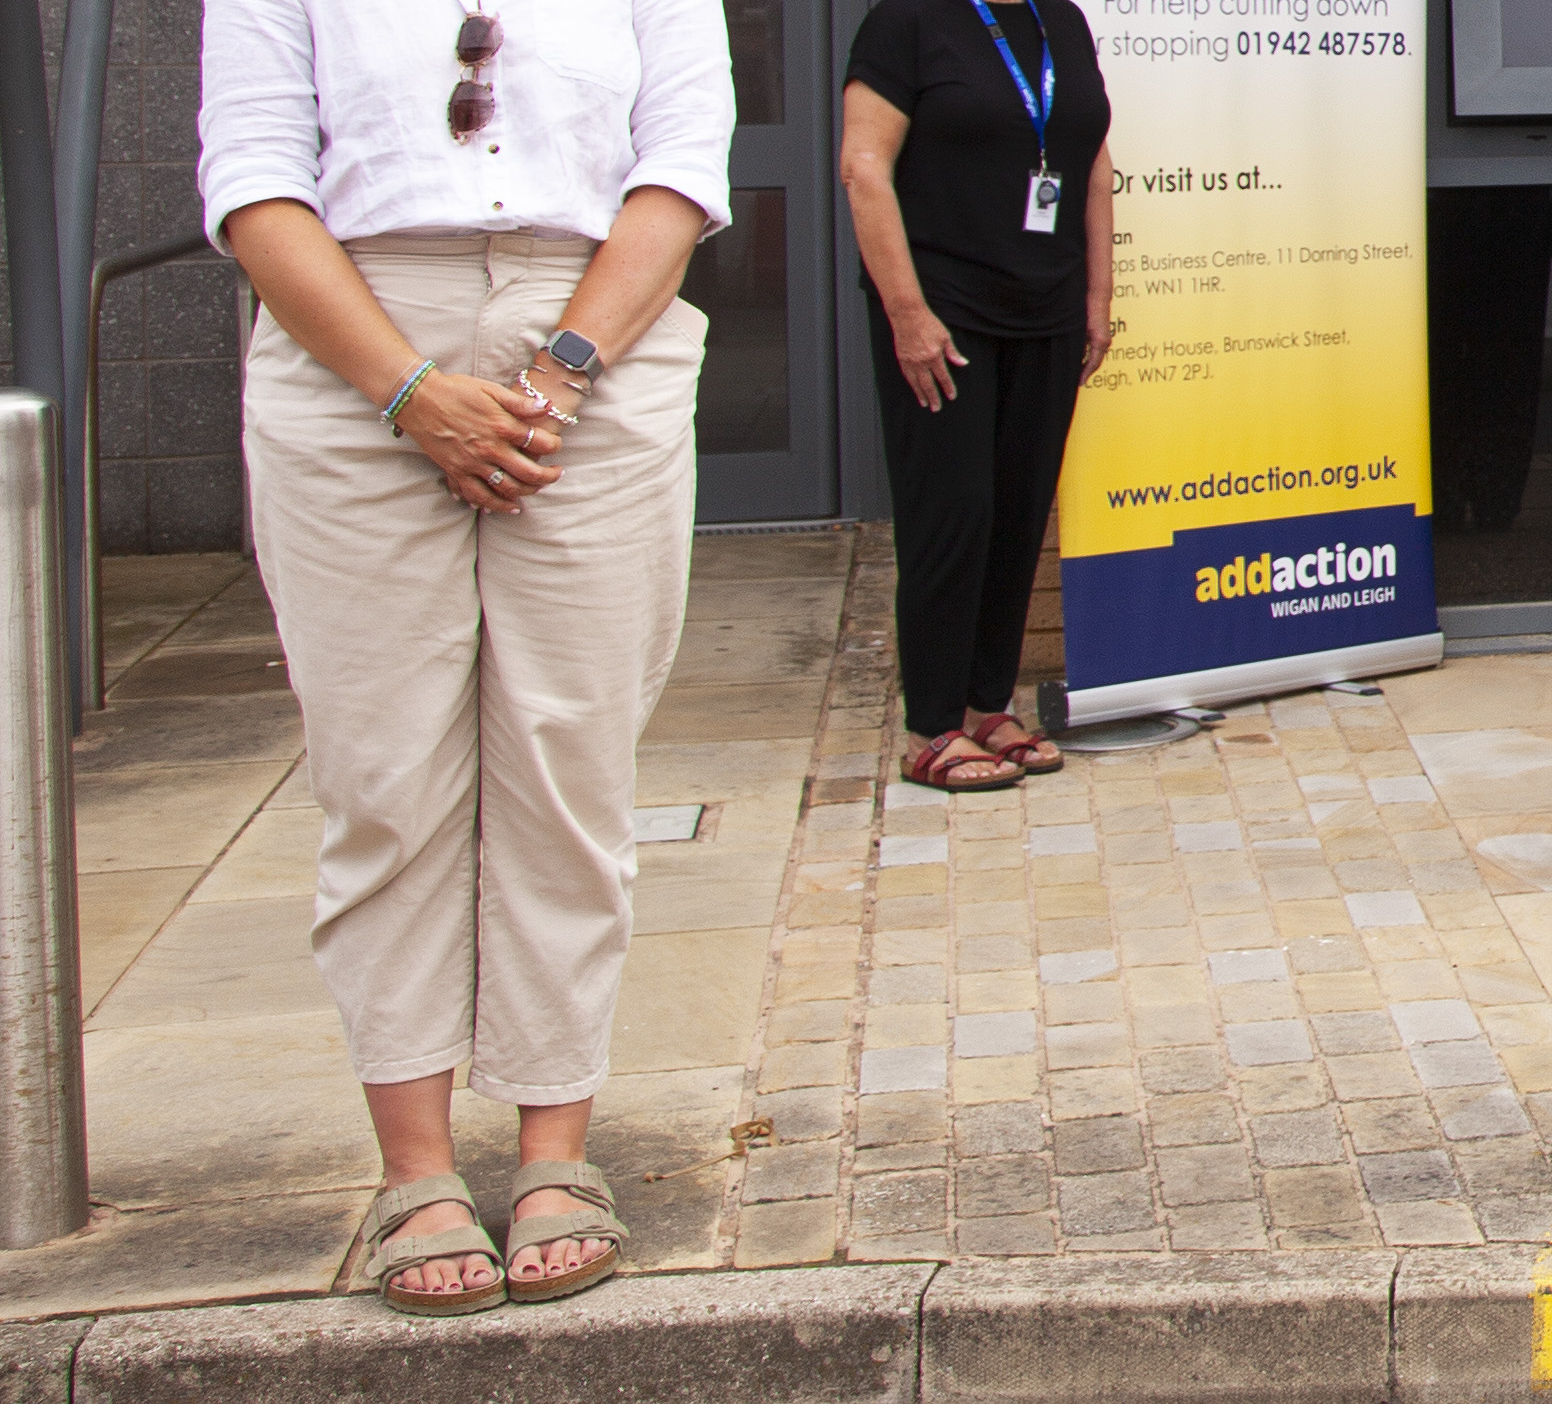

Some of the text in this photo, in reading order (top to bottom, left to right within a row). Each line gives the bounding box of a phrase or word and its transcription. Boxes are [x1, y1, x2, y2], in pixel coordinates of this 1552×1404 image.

[1112, 31, 1228, 62] stopping
[1236, 31, 1311, 56] 01942
[1318, 31, 1412, 56] 487578.
[1143, 168, 1193, 193] visit
[1202, 171, 1227, 191] us
[1236, 166, 1282, 190] at...
[1141, 251, 1207, 272] Business
[1212, 249, 1271, 268] Centre,
[1277, 248, 1292, 264] 11
[1300, 246, 1358, 264] Dorning
[1362, 243, 1413, 260] Street,
[1145, 279, 1183, 296] WN1
[1191, 277, 1225, 294] 1HR.
[1107, 329, 1350, 363] nnedy House, Brunswick Street,
[1138, 366, 1176, 383] WN7
[1182, 364, 1213, 382] 2PJ.
[1106, 455, 1397, 509] www.addaction.org.uk
[1195, 542, 1397, 603] addaction
[1271, 586, 1395, 618] WIGAN AND LEIGH
